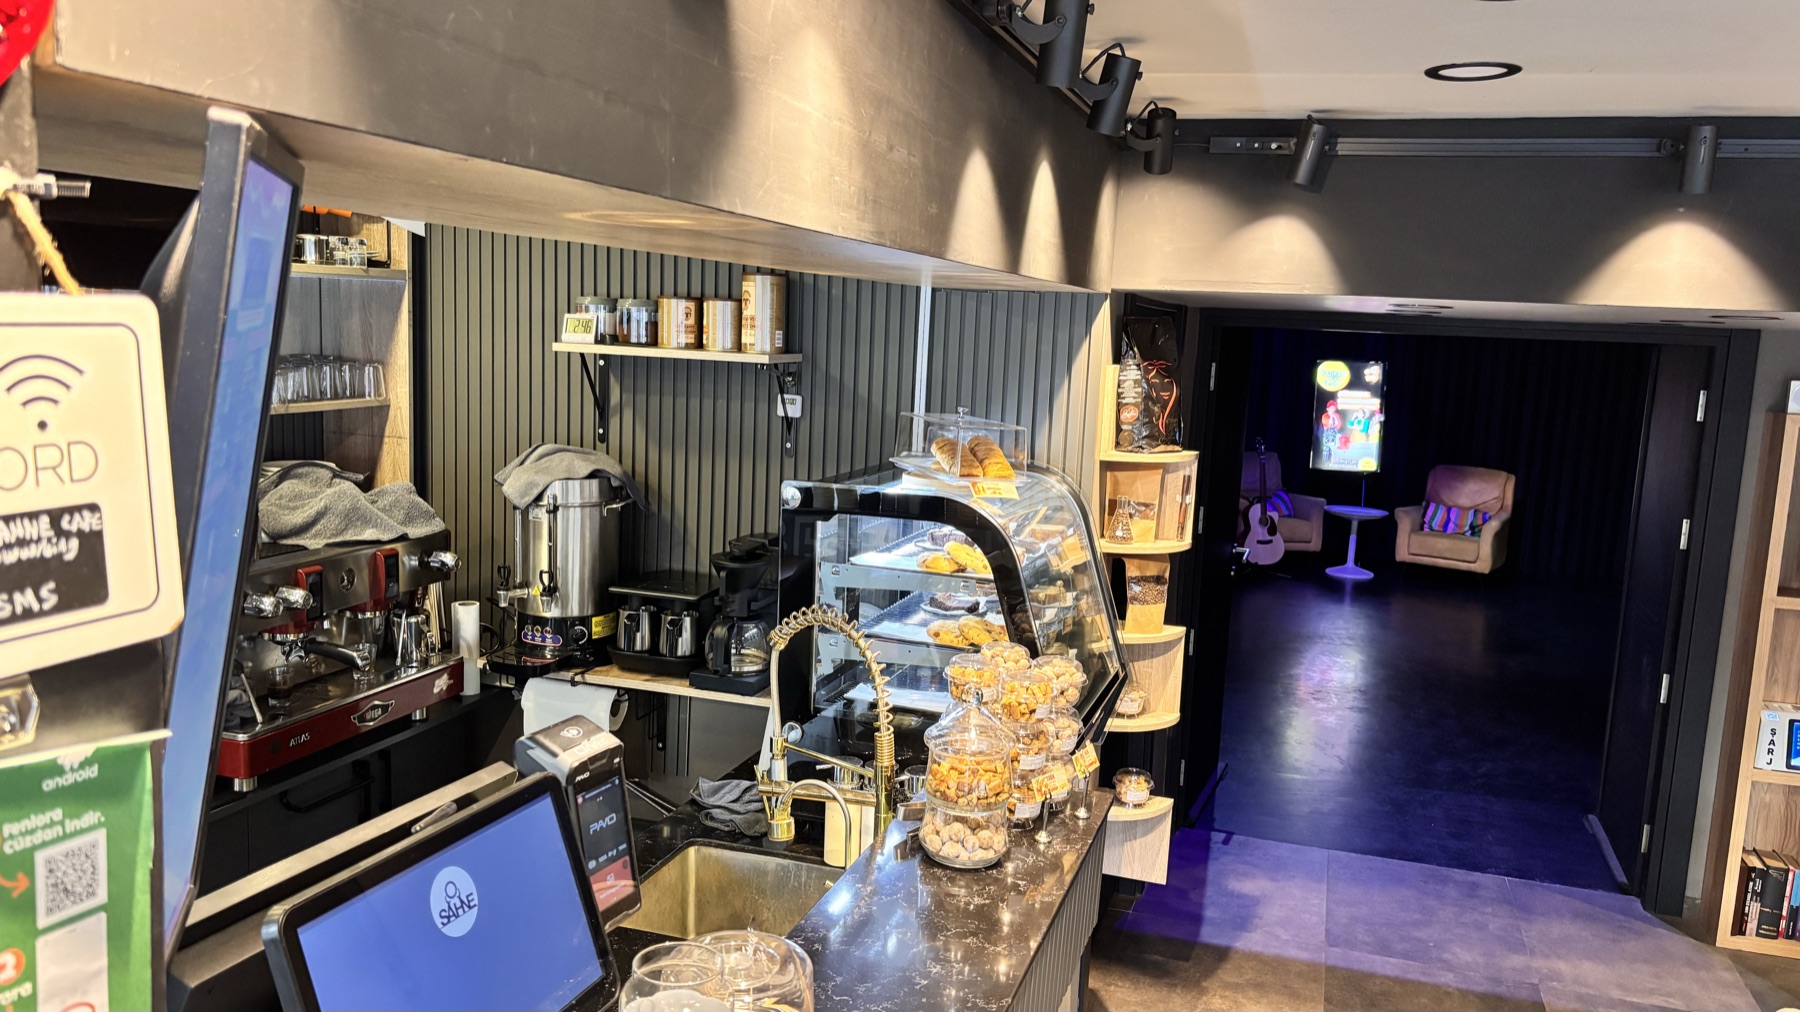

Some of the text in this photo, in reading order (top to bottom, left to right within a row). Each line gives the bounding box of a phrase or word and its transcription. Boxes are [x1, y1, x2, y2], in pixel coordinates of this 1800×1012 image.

[289, 732, 311, 747] ATLAS
[41, 763, 99, 791] android
[439, 891, 478, 927] SAHNE
